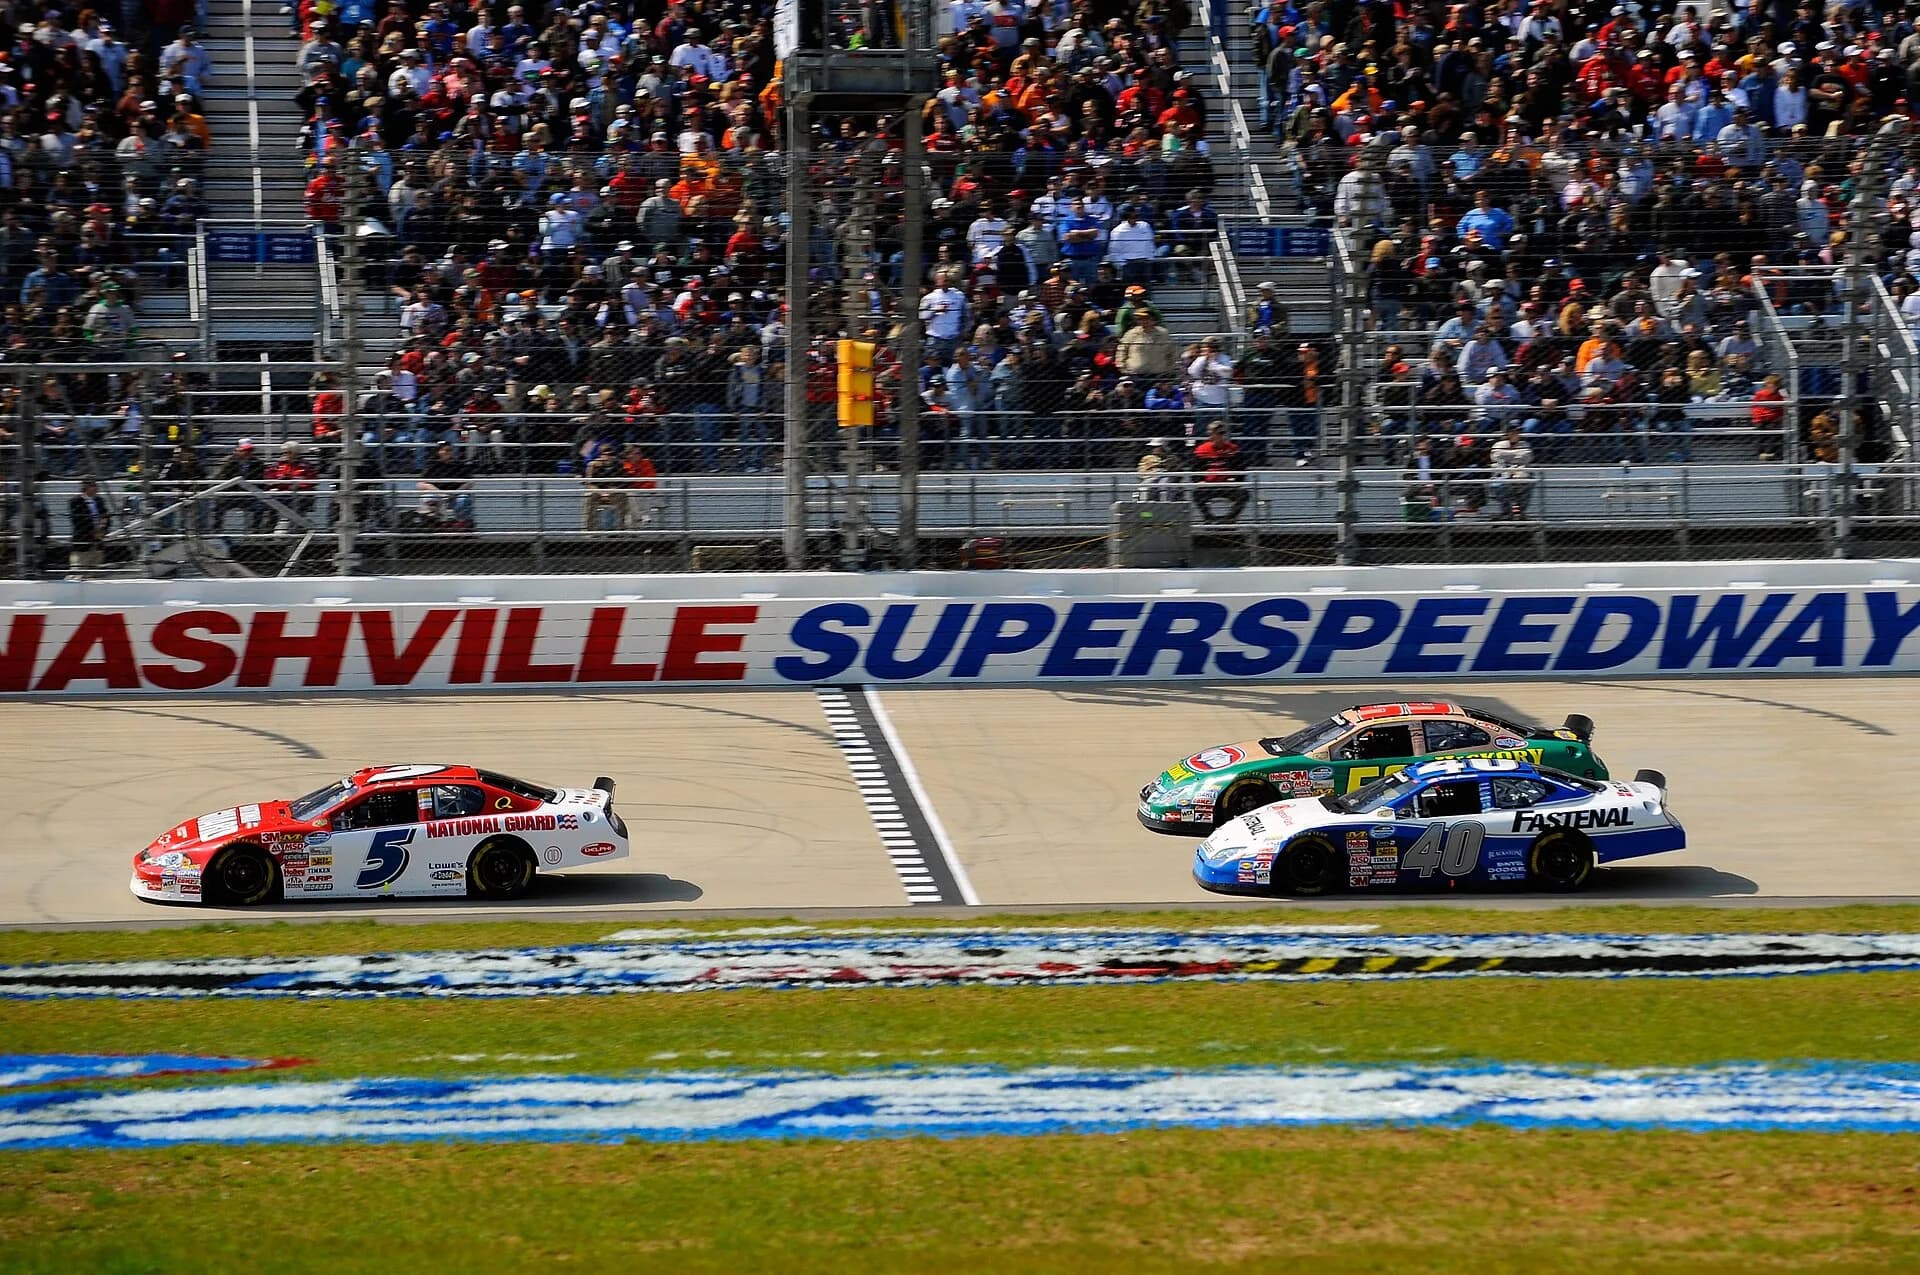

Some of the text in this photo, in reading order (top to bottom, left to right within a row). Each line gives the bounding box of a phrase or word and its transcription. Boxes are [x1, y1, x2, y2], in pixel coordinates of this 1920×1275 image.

[775, 591, 1920, 682] SUPERSPEEDWAY
[1290, 771, 1308, 780] 3M
[426, 815, 556, 838] NATIONAL GUARD
[1512, 807, 1634, 833] FASTENAL
[261, 832, 280, 842] 3M
[1401, 820, 1486, 878] 40
[356, 828, 417, 890] 5
[1350, 877, 1368, 886] 3M
